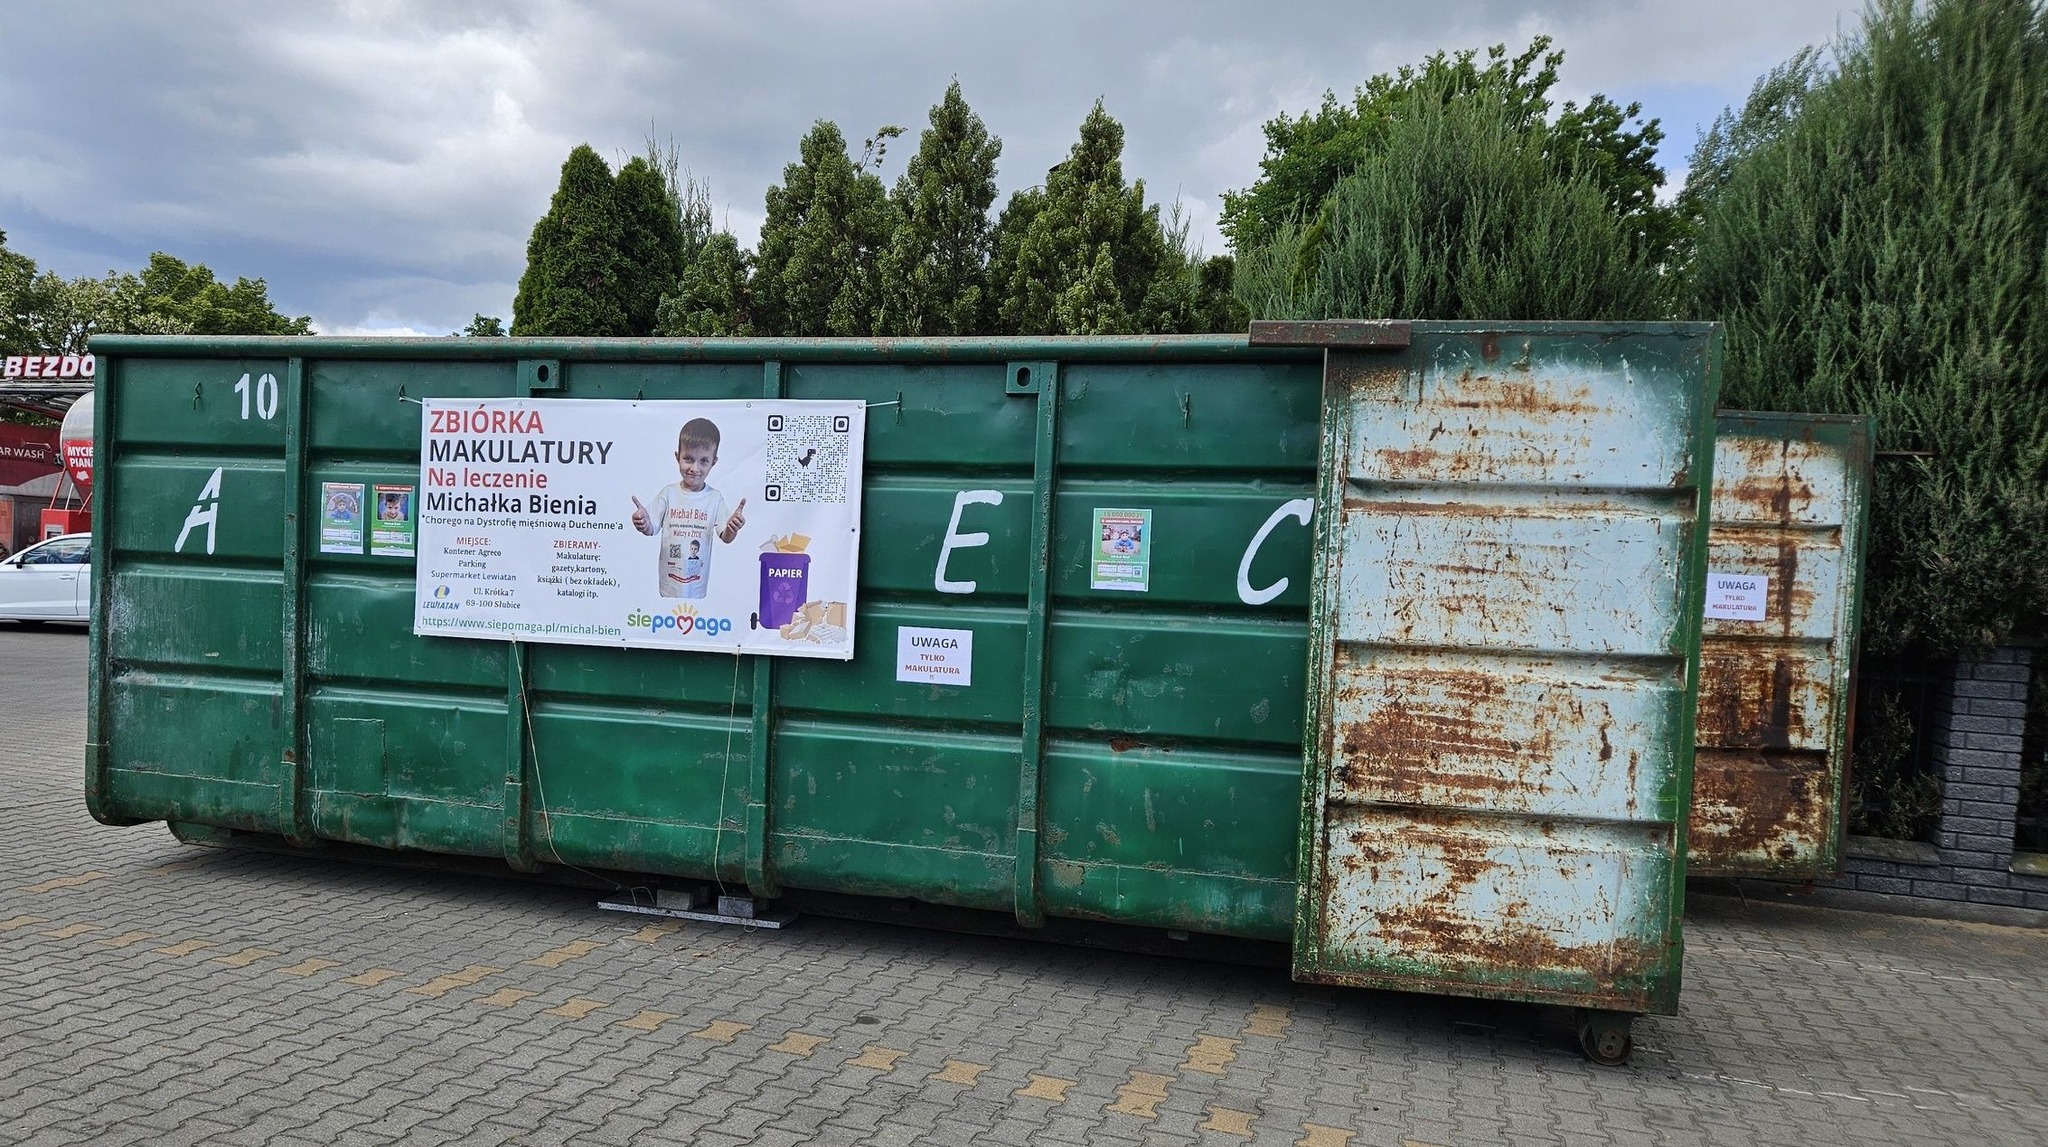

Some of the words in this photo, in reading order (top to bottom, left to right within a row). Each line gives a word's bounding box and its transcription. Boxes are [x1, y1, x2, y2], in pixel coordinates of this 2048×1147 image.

[235, 373, 278, 420] 10
[430, 404, 544, 434] ZBIÓRKA
[13, 447, 44, 459] WASH
[429, 439, 613, 465] MAKULATURY
[428, 468, 456, 487] Na
[464, 468, 547, 488] leczenie
[427, 492, 521, 513] Michałka
[530, 494, 597, 515] Bienia
[174, 467, 222, 555] A
[464, 518, 474, 526] na
[477, 518, 517, 529] Dystrofię
[519, 519, 566, 530] mięśniową
[569, 520, 623, 530] Duchenne'a
[456, 537, 491, 546] MIEJSCE:
[935, 489, 1004, 594] E
[478, 549, 501, 557] Agreco
[556, 552, 601, 562] Makulaturę:
[1237, 498, 1315, 605] C
[458, 560, 486, 569] Parking
[431, 570, 480, 580] Supermarket
[482, 572, 516, 581] Lewiatan
[768, 568, 802, 579] PAPIER
[537, 575, 562, 585] książki
[1718, 580, 1756, 591] UWAGA
[484, 588, 508, 596] Krótka
[557, 588, 585, 599] katalogi
[586, 589, 599, 599] itp.
[423, 601, 459, 610] LEWIATAN
[465, 600, 493, 608] 69-100
[494, 600, 520, 609] Słubice
[422, 615, 621, 635] https://www.siepomaga.pl/michal-bien
[627, 608, 731, 636] siepomaga
[911, 636, 958, 649] UWAGA
[920, 653, 945, 662] TYLKO
[905, 664, 960, 674] MAKULATURA
